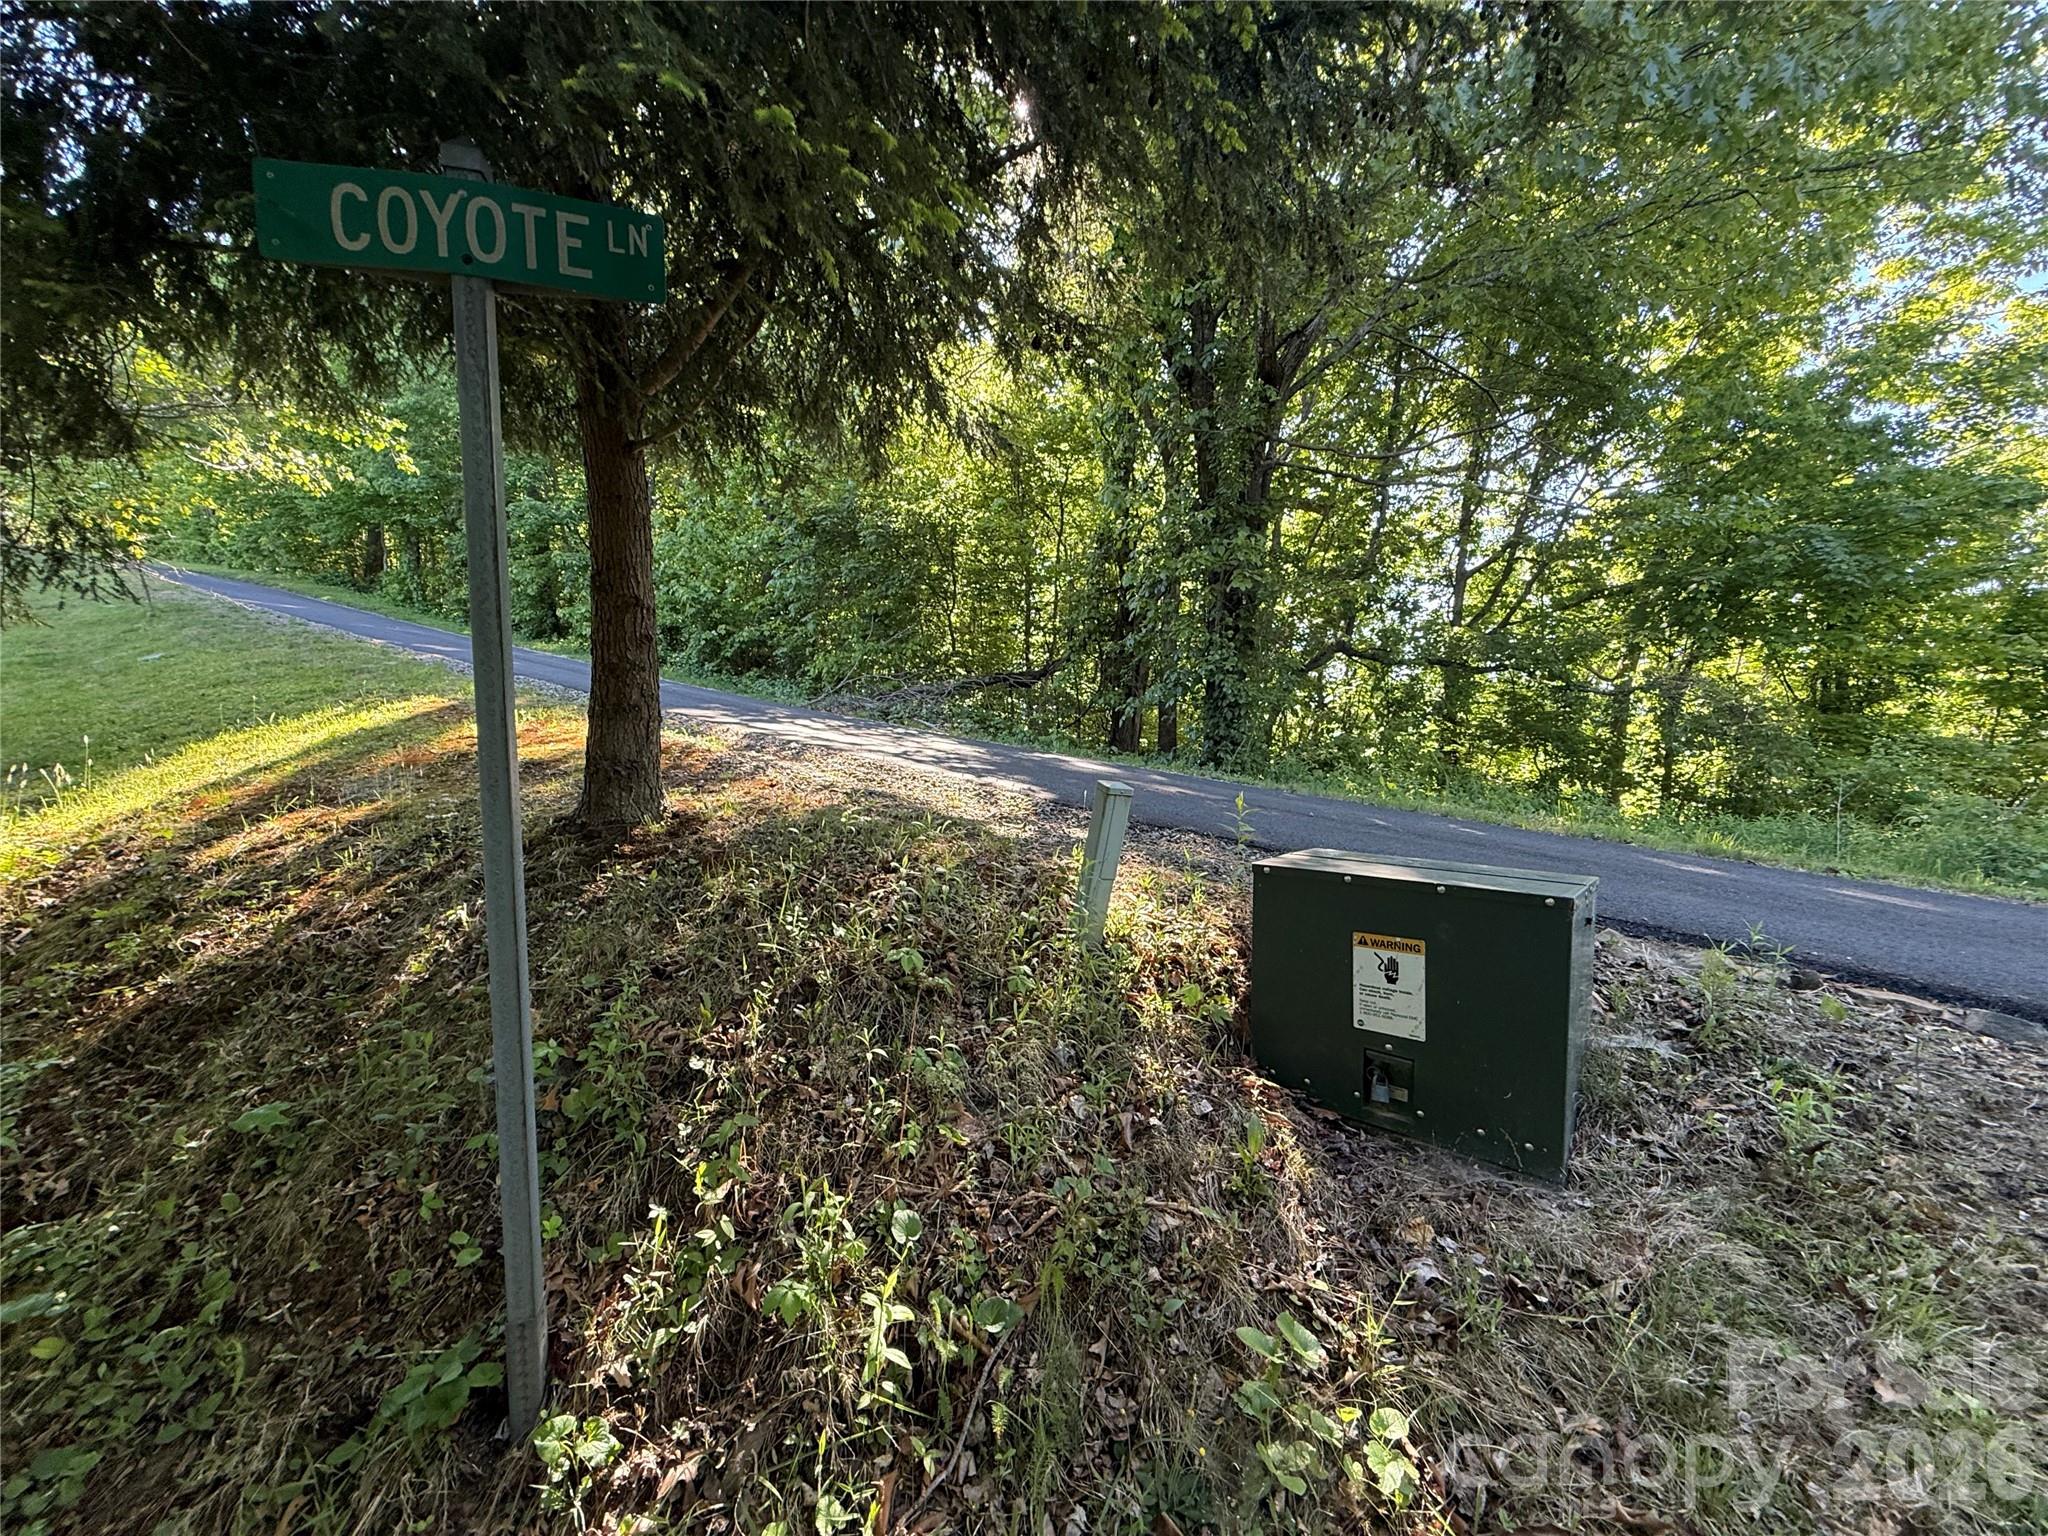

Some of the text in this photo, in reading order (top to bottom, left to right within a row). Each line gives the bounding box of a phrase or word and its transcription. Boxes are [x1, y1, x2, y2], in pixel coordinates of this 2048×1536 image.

[330, 182, 648, 279] COYOTE LN
[1369, 938, 1421, 953] WARNING
